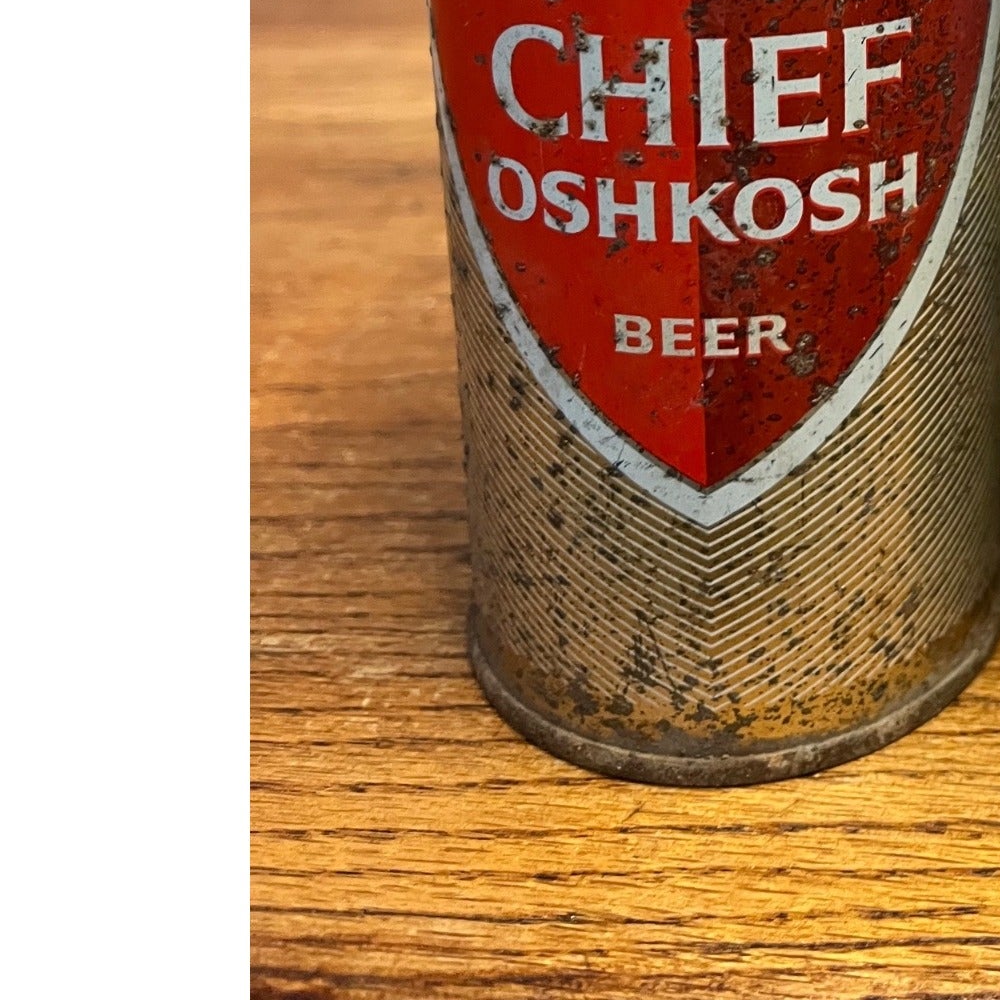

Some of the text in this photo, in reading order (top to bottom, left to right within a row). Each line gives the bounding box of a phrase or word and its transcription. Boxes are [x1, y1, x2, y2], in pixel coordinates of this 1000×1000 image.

[490, 16, 914, 149] CHIEF
[486, 150, 920, 246] OSHKOSH
[613, 313, 792, 360] BEER
